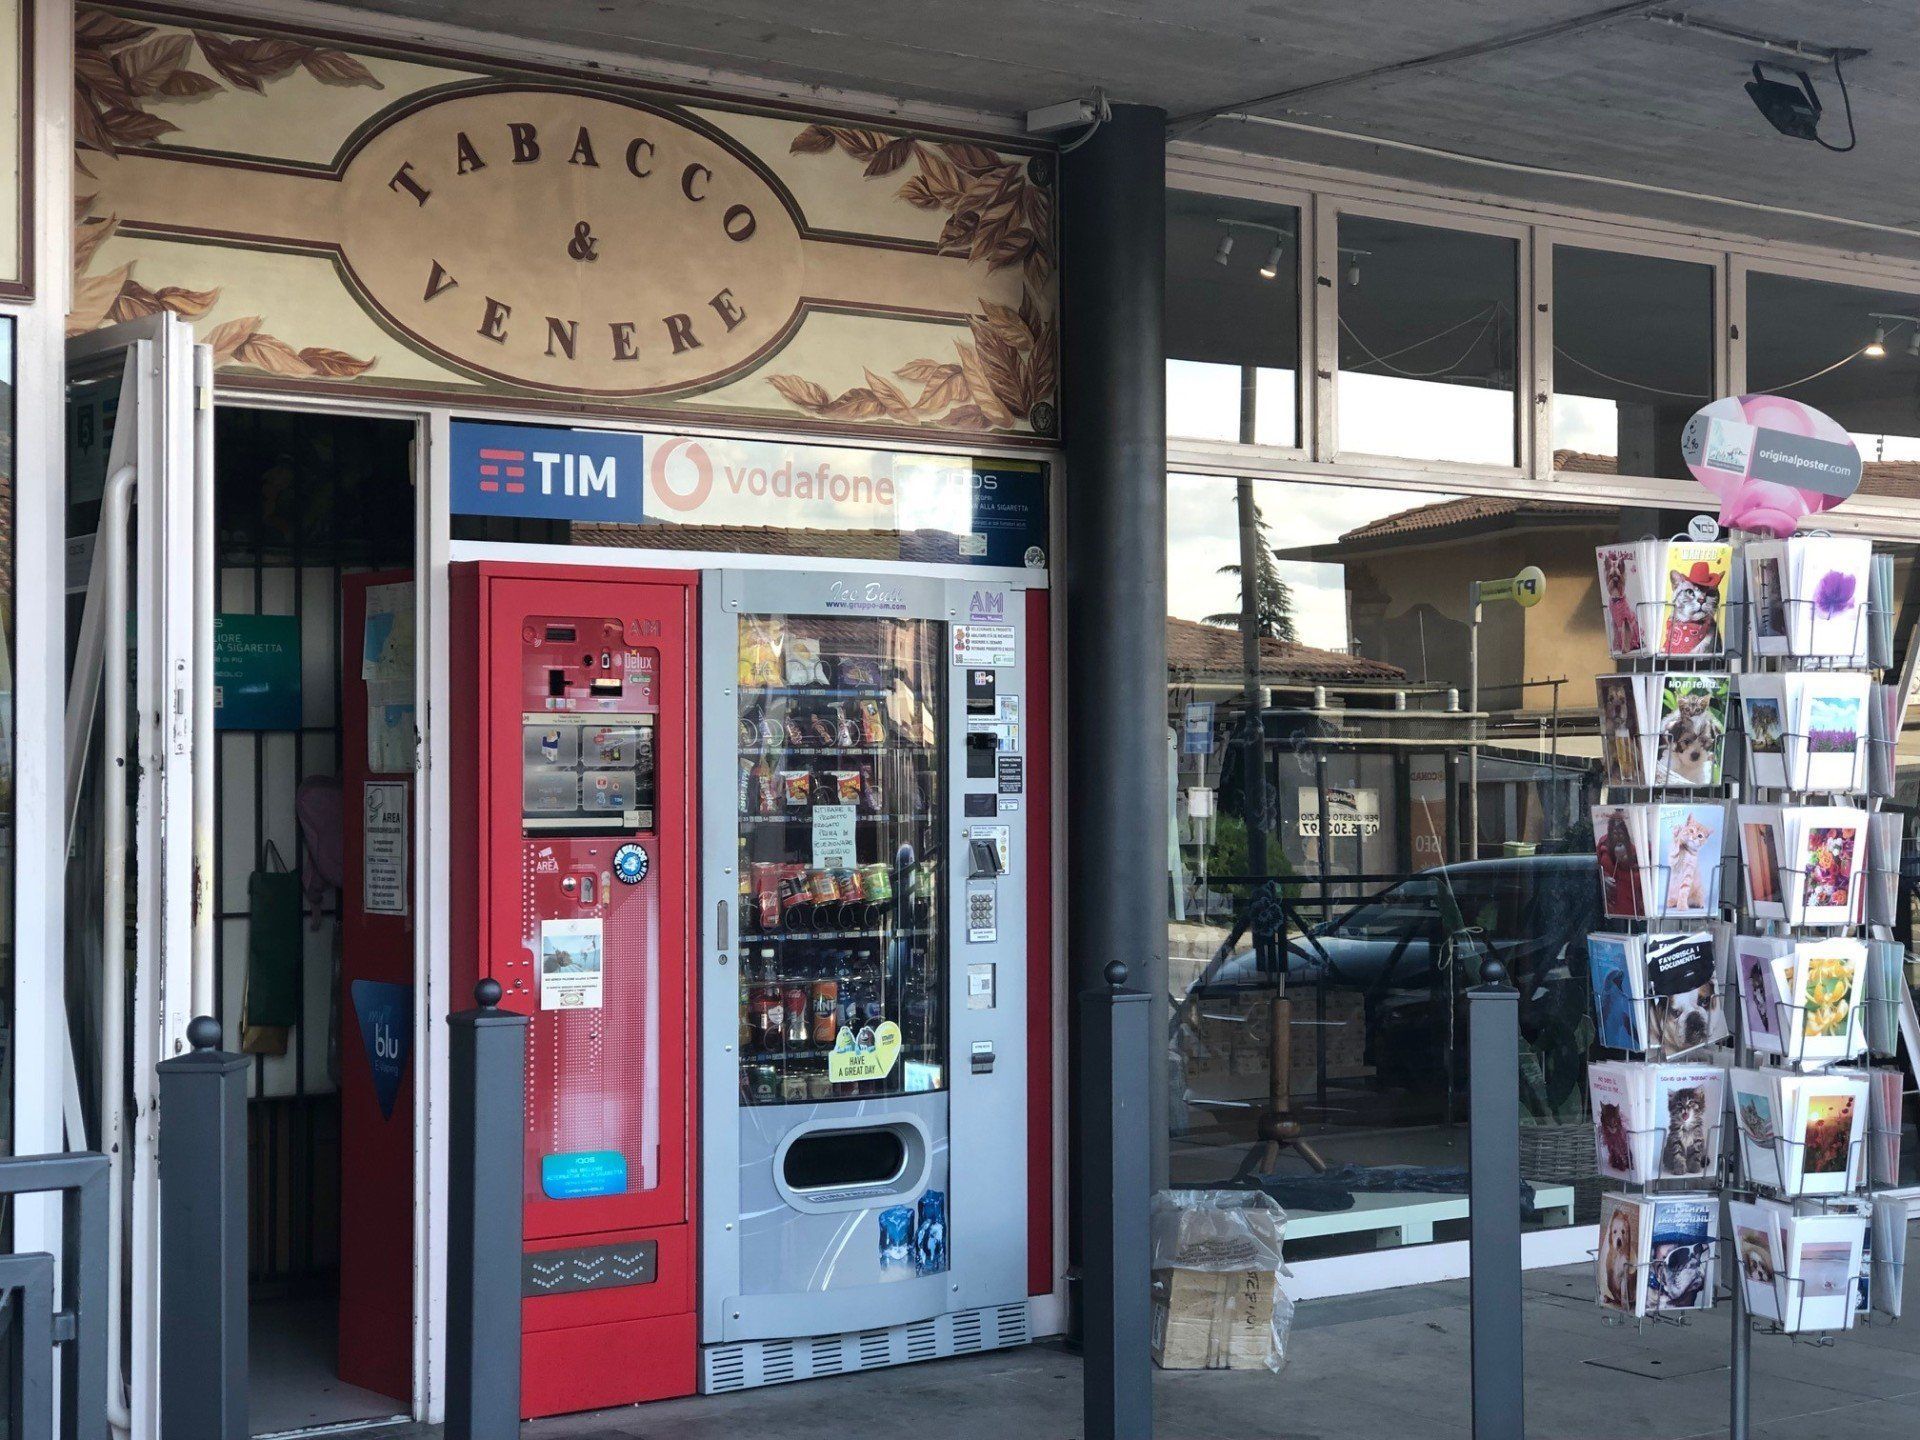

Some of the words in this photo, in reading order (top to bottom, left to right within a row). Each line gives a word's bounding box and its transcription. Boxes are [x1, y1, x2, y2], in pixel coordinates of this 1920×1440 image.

[388, 122, 758, 243] TABACCO
[567, 220, 599, 262] &
[421, 258, 747, 361] VENERE
[1759, 447, 1851, 477] originalposter.com
[532, 451, 617, 498] TIM
[724, 461, 895, 506] vodafone
[830, 580, 859, 602] Ice
[825, 601, 907, 611] www.gruppo-am.com
[970, 590, 1004, 613] AM
[227, 643, 282, 653] SIGARETTA
[624, 650, 652, 670] Delux
[382, 812, 401, 824] AREA
[621, 844, 648, 862] BULLDOG
[536, 859, 560, 872] AREA
[616, 866, 648, 884] AMSTERDAM
[1658, 947, 1695, 965] FAVORISCA
[375, 1022, 398, 1059] blu
[849, 1055, 865, 1066] HAVE
[838, 1069, 843, 1077] A
[844, 1066, 864, 1077] GREAT
[865, 1065, 876, 1075] DAY
